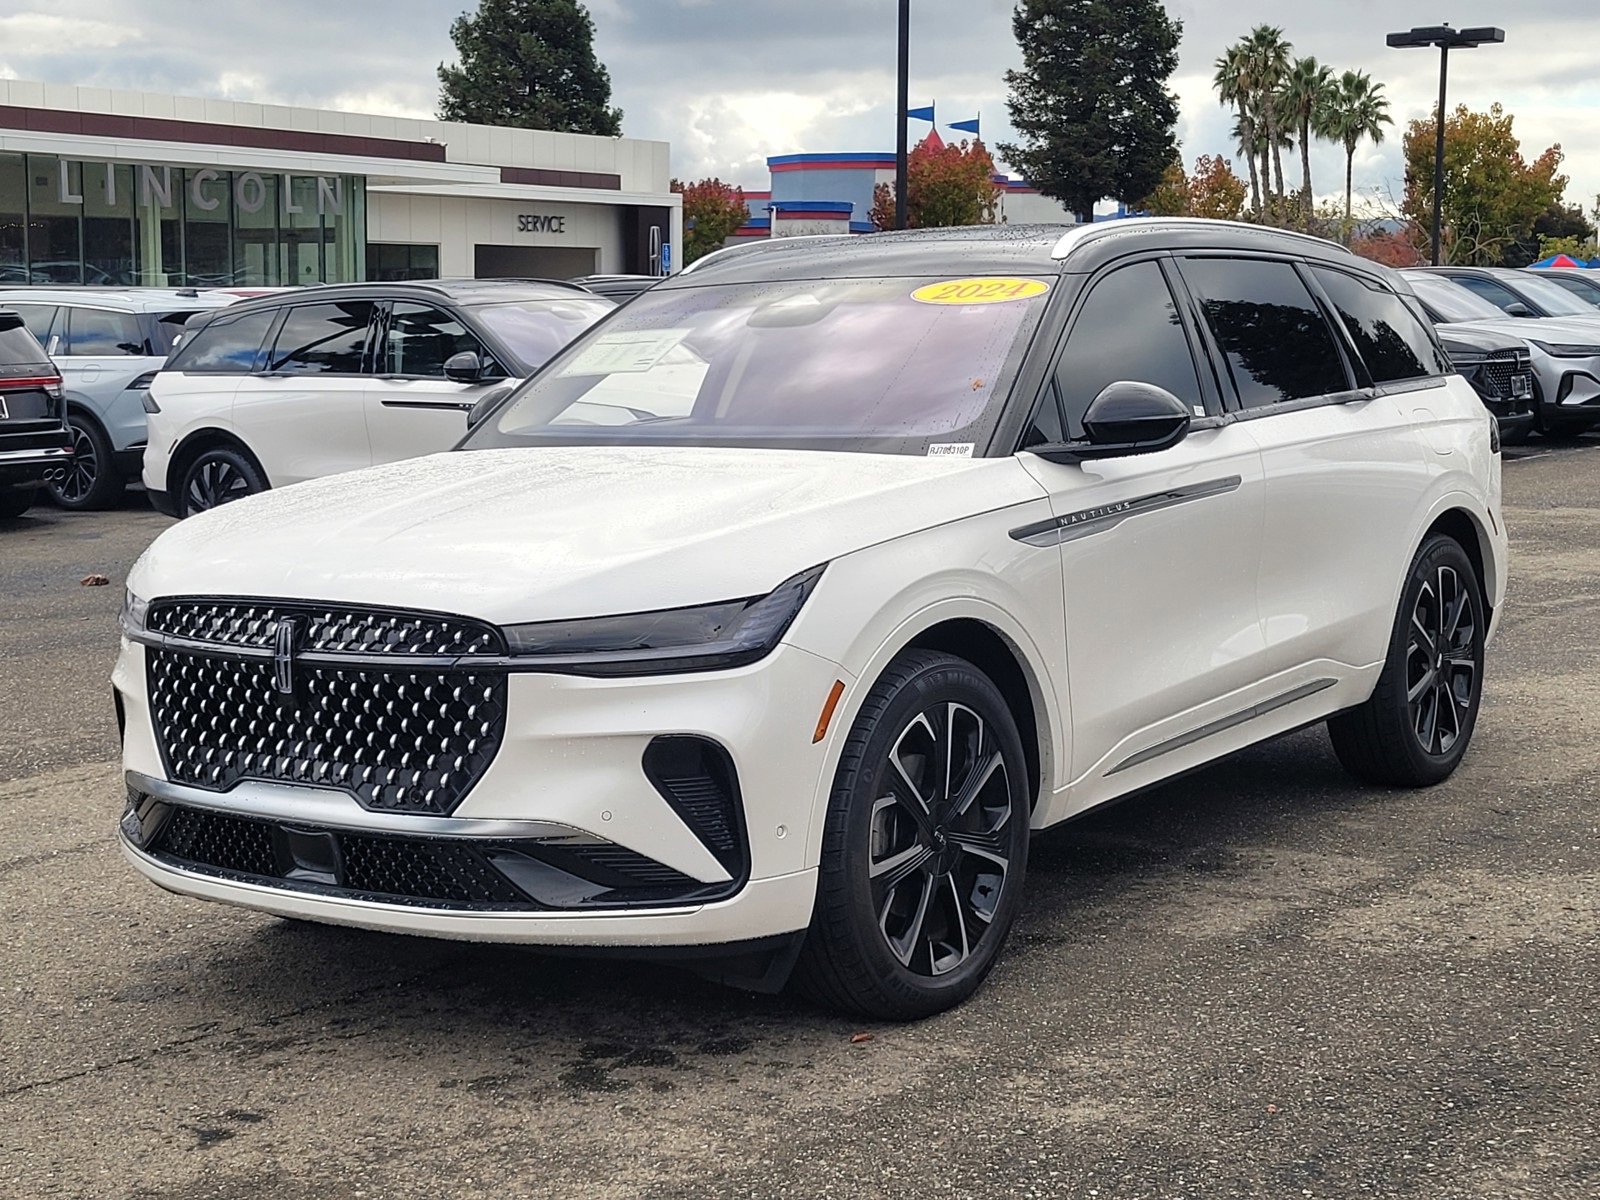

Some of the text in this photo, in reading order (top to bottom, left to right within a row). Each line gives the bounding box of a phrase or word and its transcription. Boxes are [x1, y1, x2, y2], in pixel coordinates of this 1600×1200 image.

[60, 160, 343, 215] LINCOLN
[517, 214, 566, 233] SERVICE
[931, 282, 1030, 301] 2024
[1060, 501, 1131, 526] NAUTILUS
